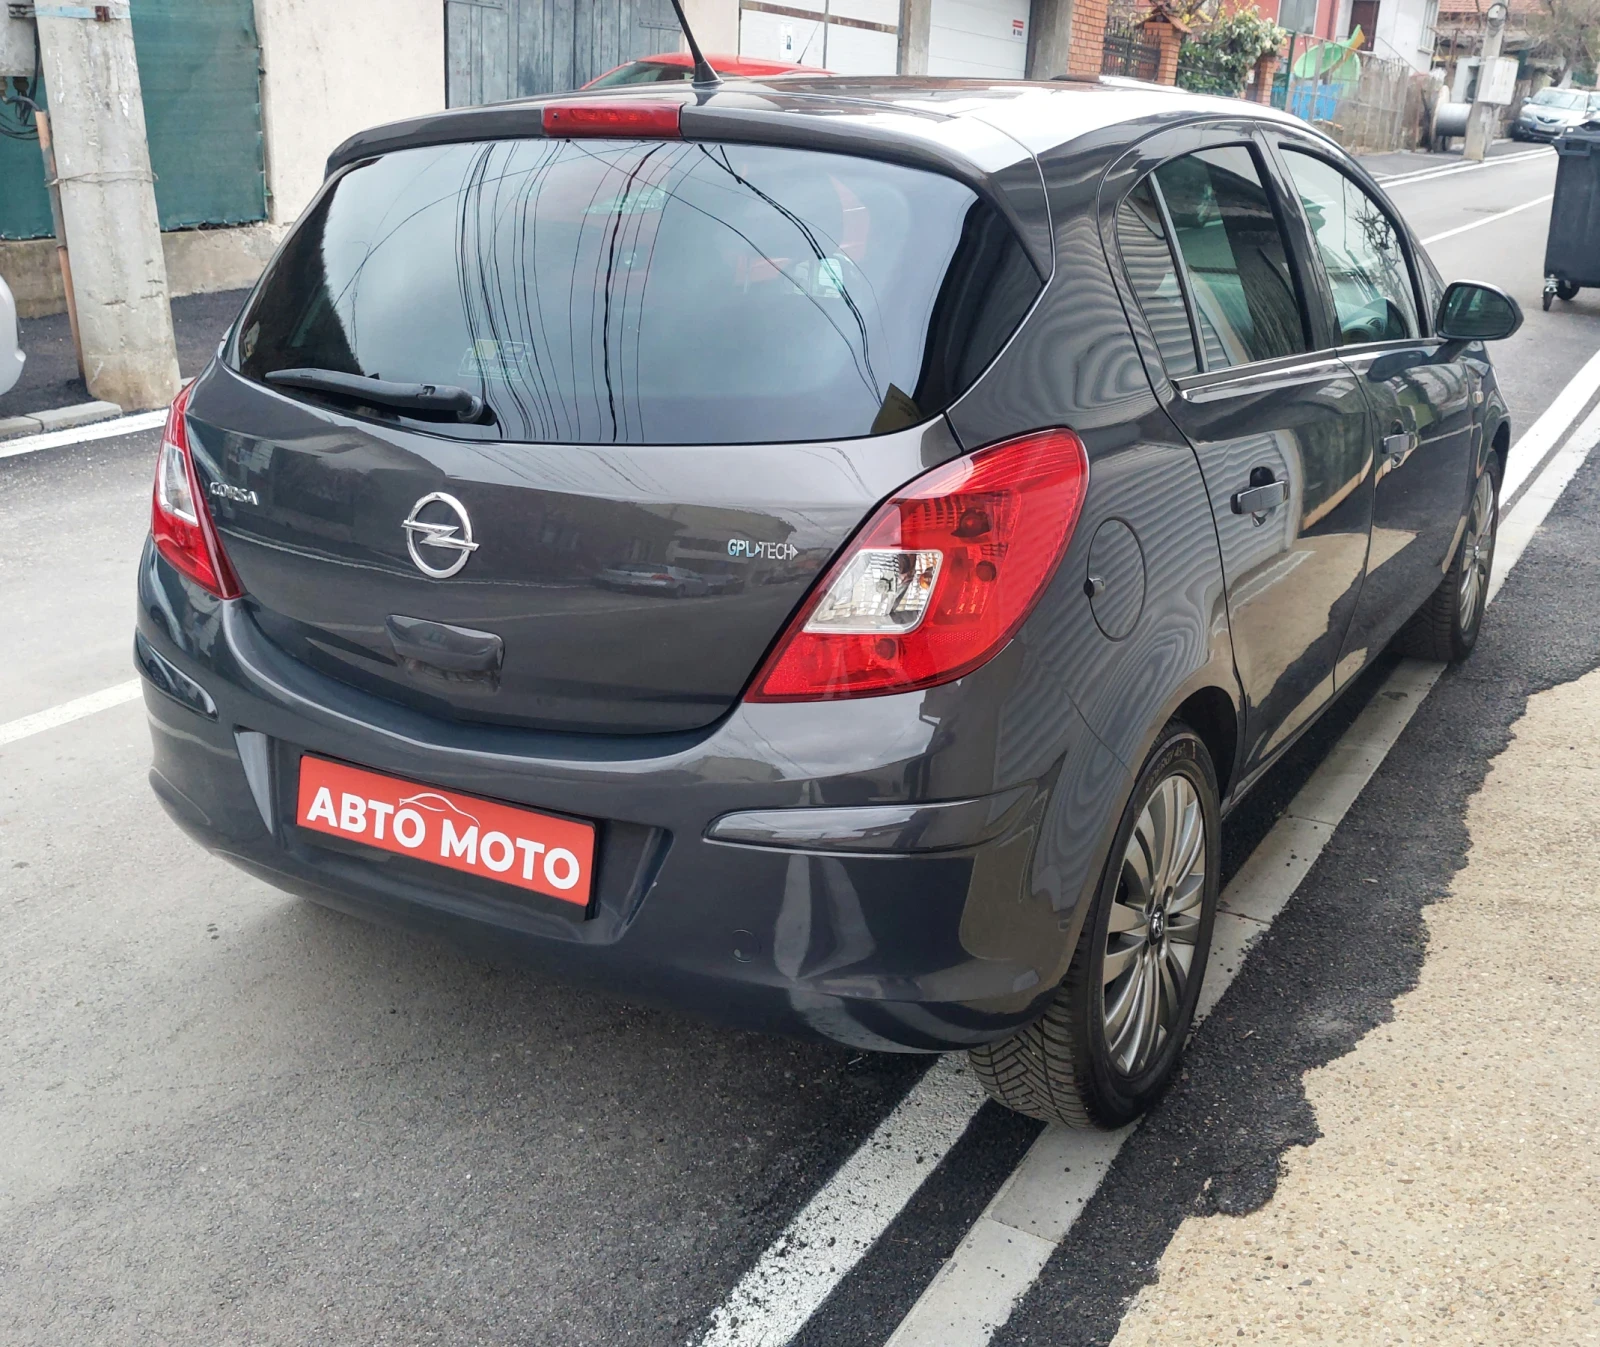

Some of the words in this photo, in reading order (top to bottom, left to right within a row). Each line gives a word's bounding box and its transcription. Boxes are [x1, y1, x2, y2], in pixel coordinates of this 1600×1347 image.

[210, 481, 259, 506] CORSA
[306, 786, 426, 849] АВТО
[440, 818, 580, 890] МОТО
